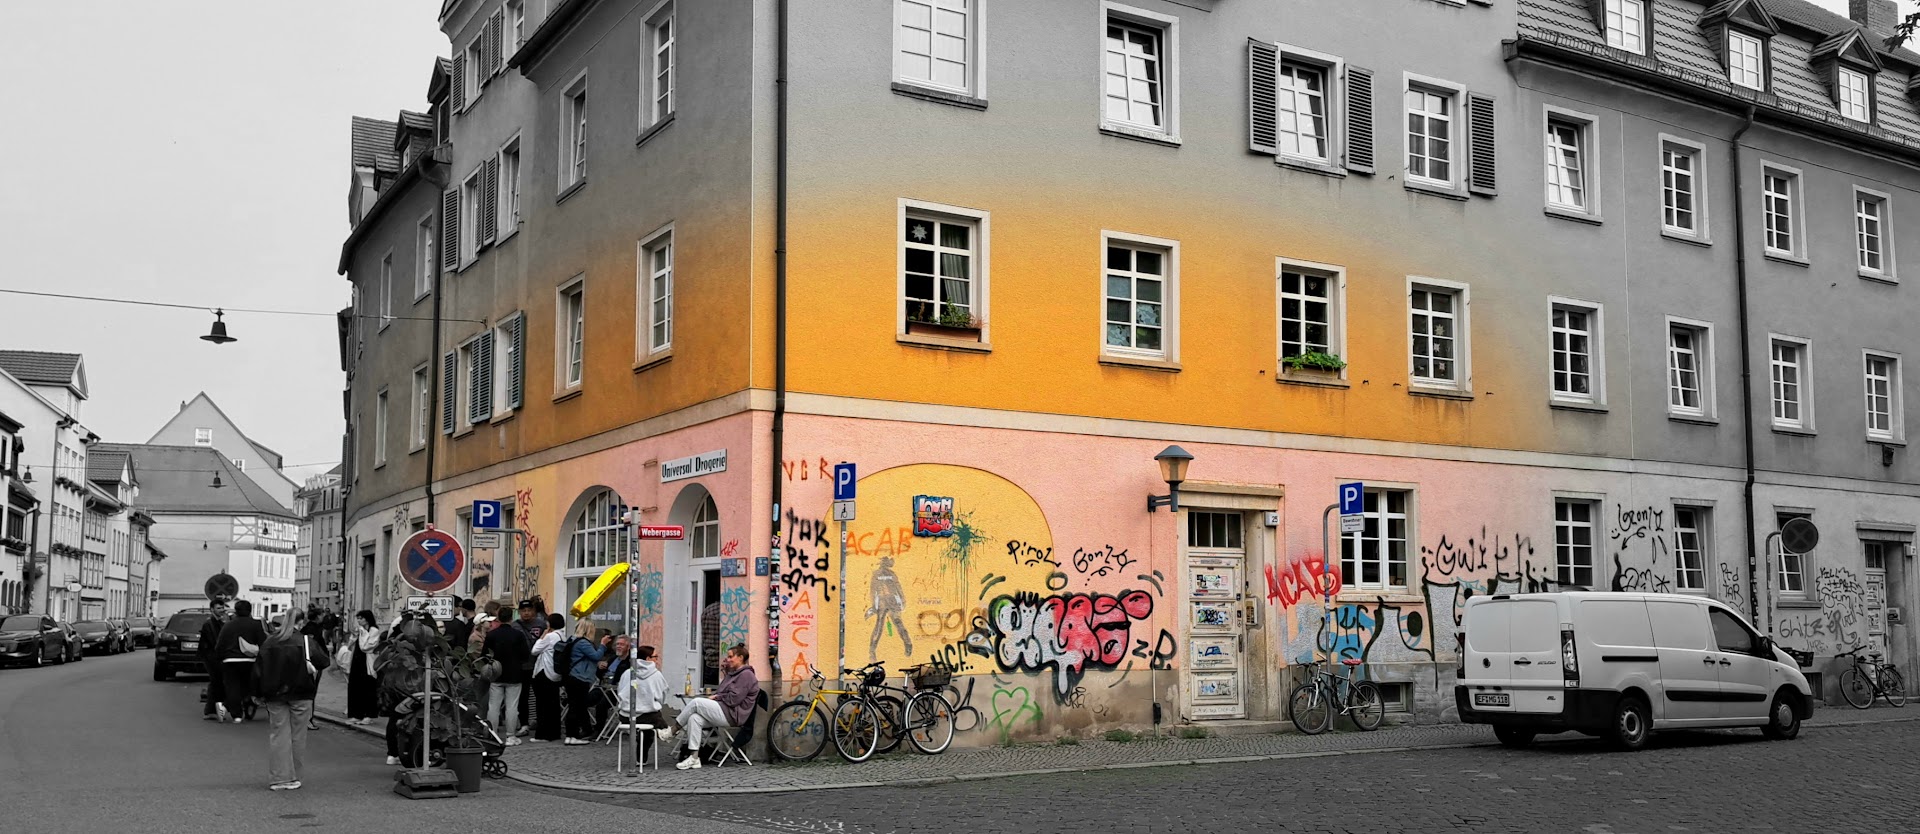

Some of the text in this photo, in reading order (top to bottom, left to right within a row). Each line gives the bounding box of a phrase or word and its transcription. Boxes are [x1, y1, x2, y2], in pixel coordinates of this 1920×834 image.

[662, 451, 725, 478] Universal Drogerie
[838, 468, 851, 496] P
[1344, 487, 1358, 511] P
[479, 503, 495, 525] P
[1271, 515, 1278, 523] 25
[641, 528, 681, 537] Webergasse
[844, 527, 914, 556] ACAB
[1264, 555, 1342, 610] ACAB
